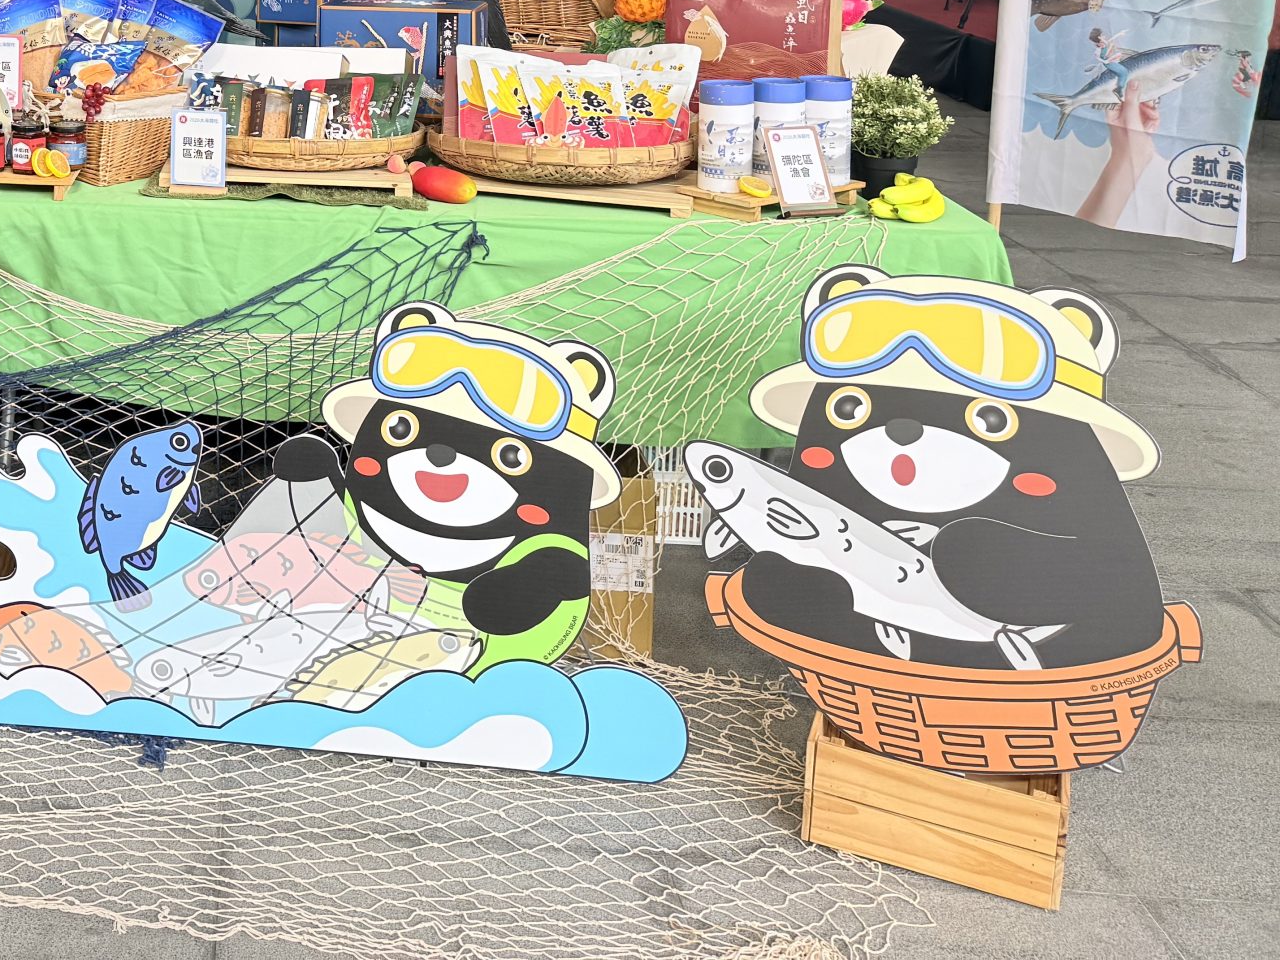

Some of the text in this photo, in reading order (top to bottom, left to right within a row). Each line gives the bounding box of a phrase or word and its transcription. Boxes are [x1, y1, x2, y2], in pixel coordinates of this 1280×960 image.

[156, 10, 177, 23] TAIWAN
[443, 19, 453, 66] 大興魚市
[182, 136, 215, 149] 興達港
[182, 148, 214, 160] 區漁會
[780, 153, 814, 166] 彌陀區
[789, 166, 811, 178] 漁會
[547, 630, 572, 656] KAOHSIUNG
[568, 615, 578, 630] BEAR
[1099, 670, 1153, 691] KAOHSIUNG
[1153, 657, 1177, 675] BEAR
